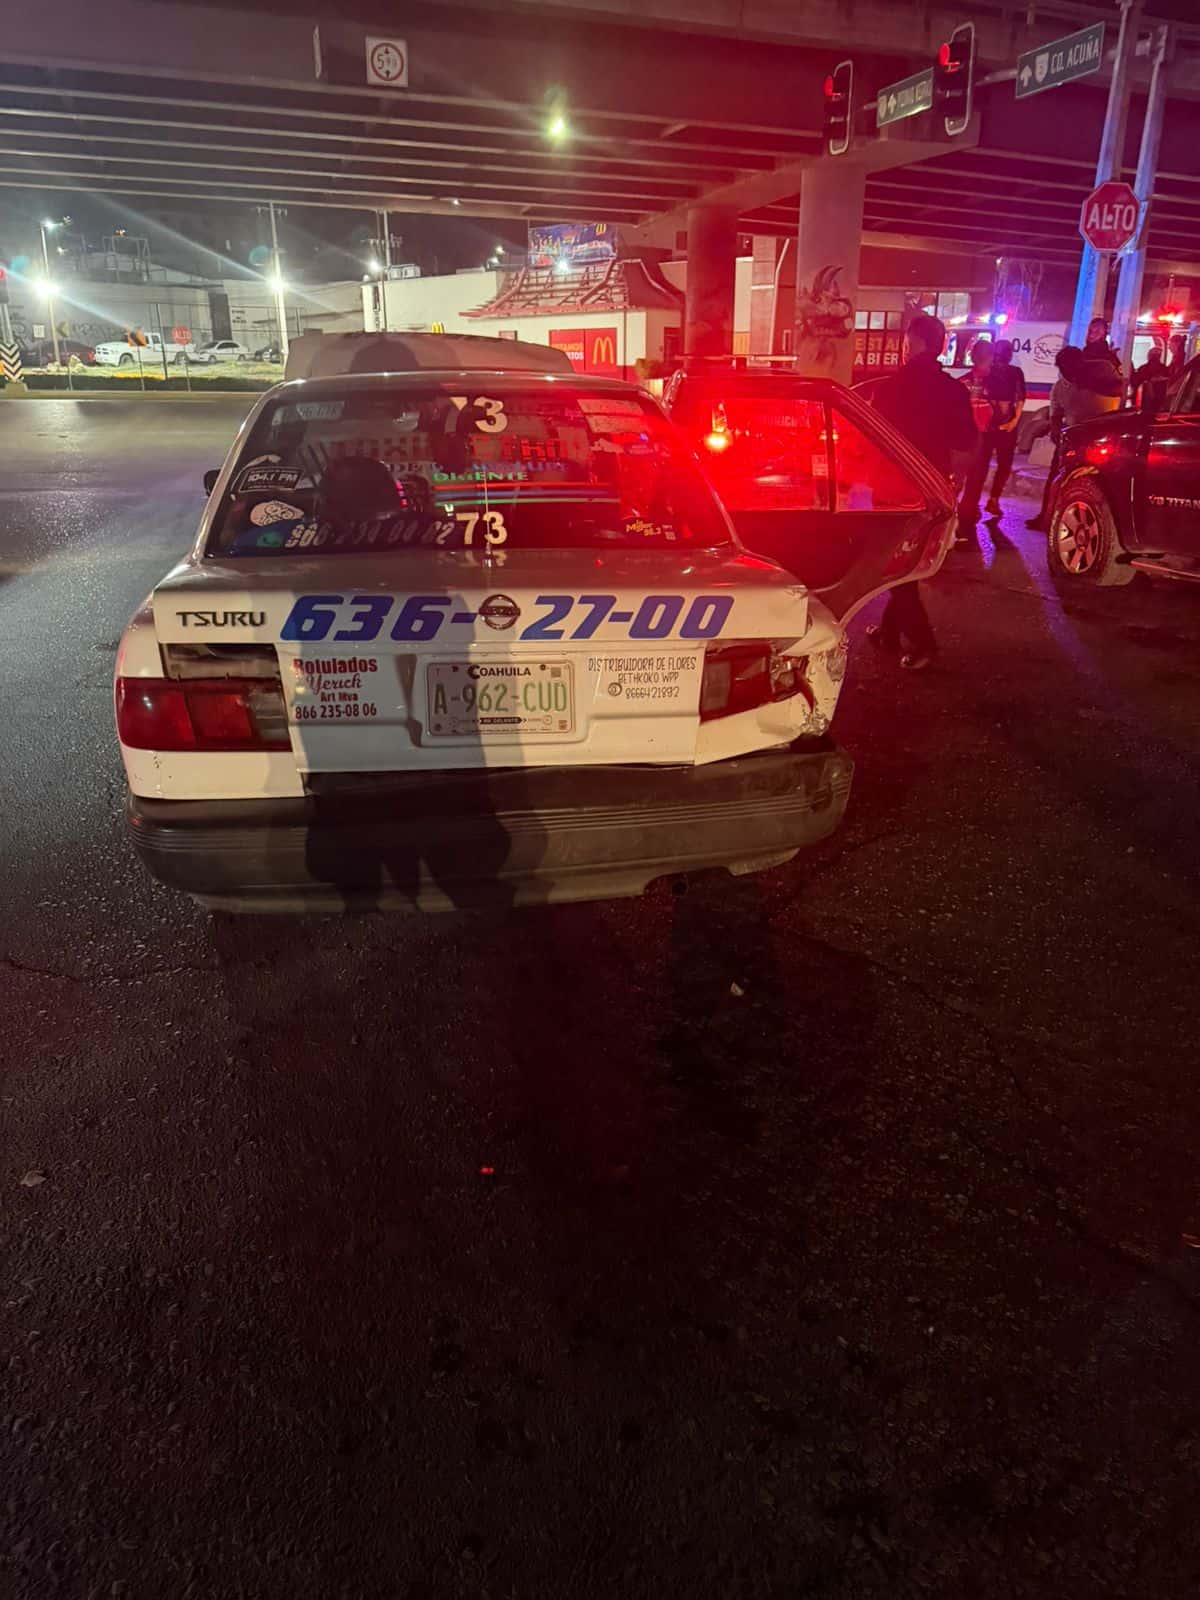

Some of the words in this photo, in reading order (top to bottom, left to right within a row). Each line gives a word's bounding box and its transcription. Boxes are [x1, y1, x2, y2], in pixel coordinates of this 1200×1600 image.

[1066, 35, 1099, 68] ACUÑA
[1086, 203, 1136, 231] ALTO
[1012, 338, 1032, 353] 04
[278, 474, 298, 482] FM
[456, 511, 508, 545] 73
[175, 610, 266, 628] TSURU
[519, 595, 735, 641] 27-00
[467, 664, 532, 680] COAHUILA
[588, 657, 654, 672] DISTRIBUIDORA
[656, 657, 666, 670] DE
[668, 656, 697, 670] FLORES
[433, 681, 568, 715] A-962-CUD
[295, 705, 317, 720] 866
[320, 703, 359, 719] 235-08
[362, 702, 377, 717] 06
